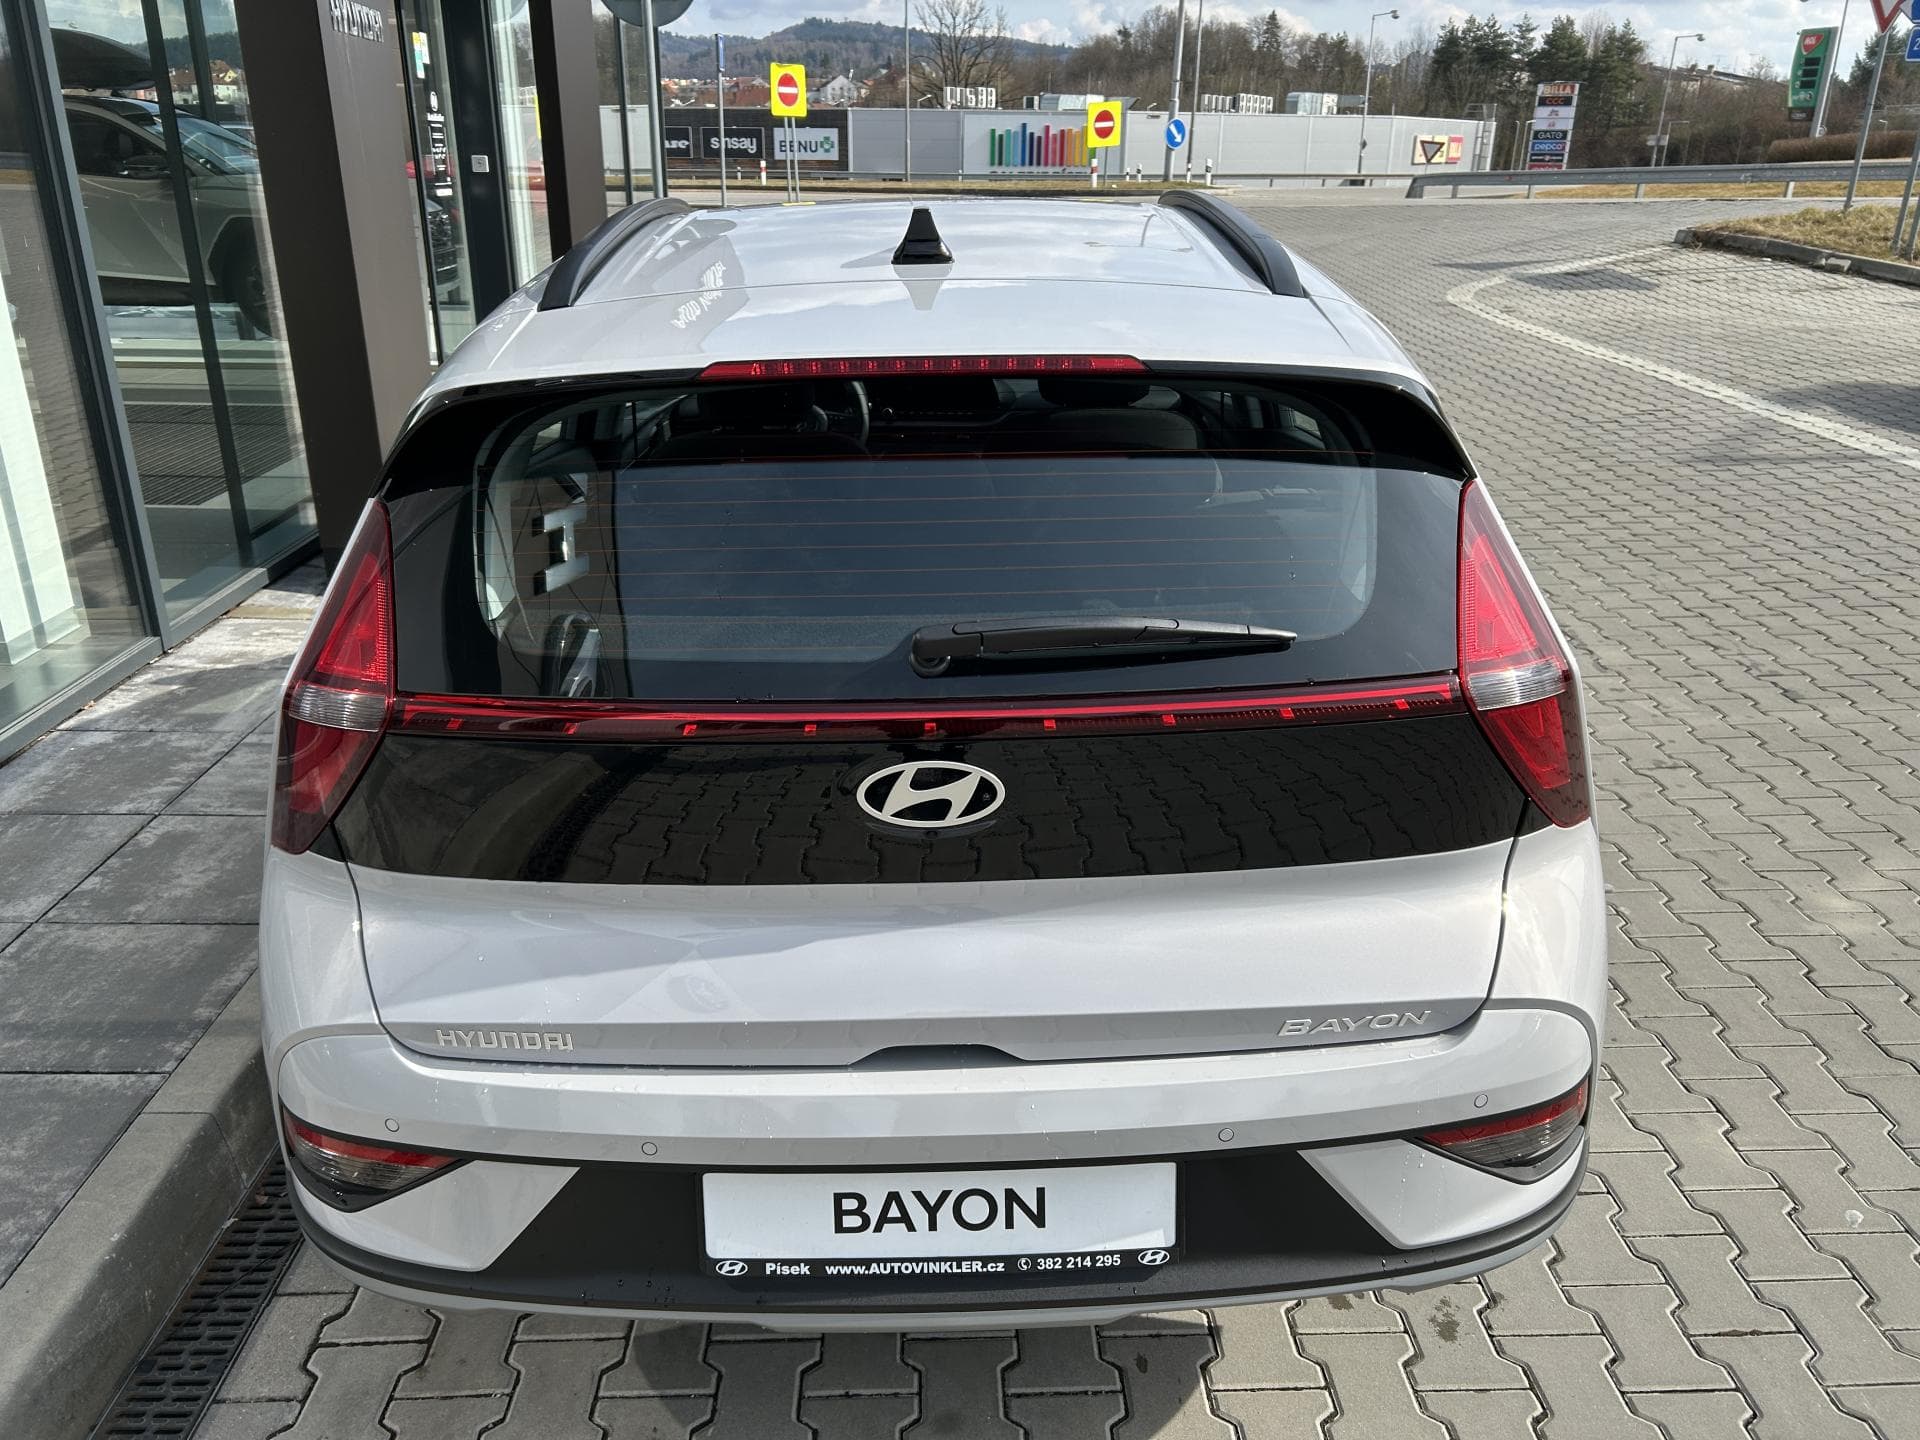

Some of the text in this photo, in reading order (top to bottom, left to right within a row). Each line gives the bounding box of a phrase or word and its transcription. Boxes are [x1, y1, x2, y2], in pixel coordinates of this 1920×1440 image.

[1543, 84, 1572, 95] BILLA
[710, 137, 757, 154] snsay
[779, 140, 818, 153] BENU
[1534, 143, 1563, 152] pepco
[1277, 1010, 1432, 1036] BAYON
[435, 1029, 574, 1050] HYUNDAI
[833, 1187, 1046, 1234] BAYON
[765, 1254, 1121, 1275] Písek www.AUTOVINKLER.cz 382 214 295
